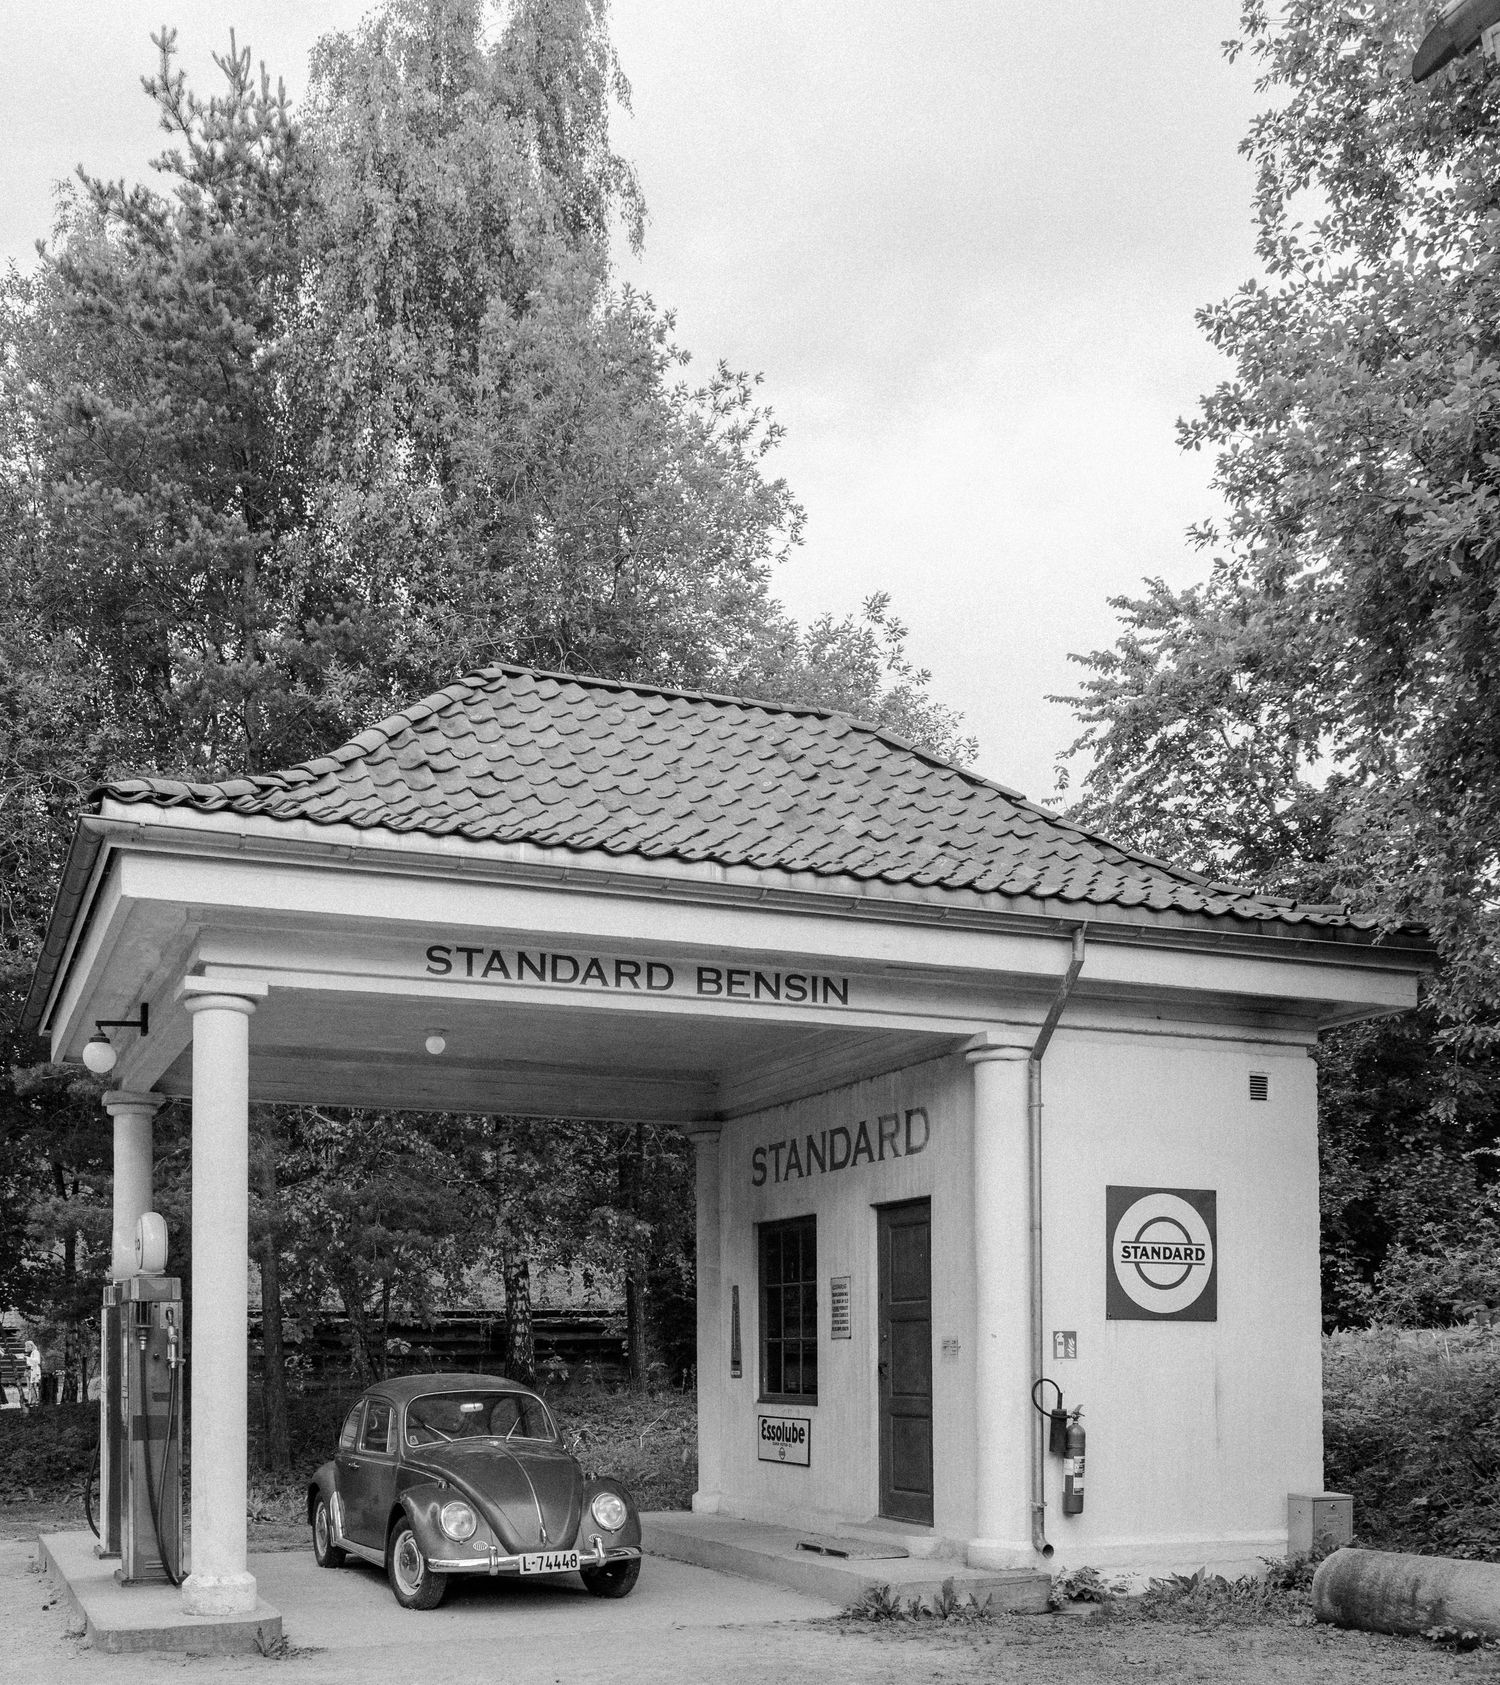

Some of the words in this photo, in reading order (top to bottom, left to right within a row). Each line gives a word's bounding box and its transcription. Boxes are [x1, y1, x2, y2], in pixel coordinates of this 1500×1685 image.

[425, 945, 674, 991] STANDARD
[696, 966, 848, 1005] BENSIN
[751, 1106, 930, 1187] STANDARD
[1121, 1245, 1206, 1261] STANDARD
[761, 1418, 806, 1444] Essolube
[523, 1553, 578, 1572] L-74448
